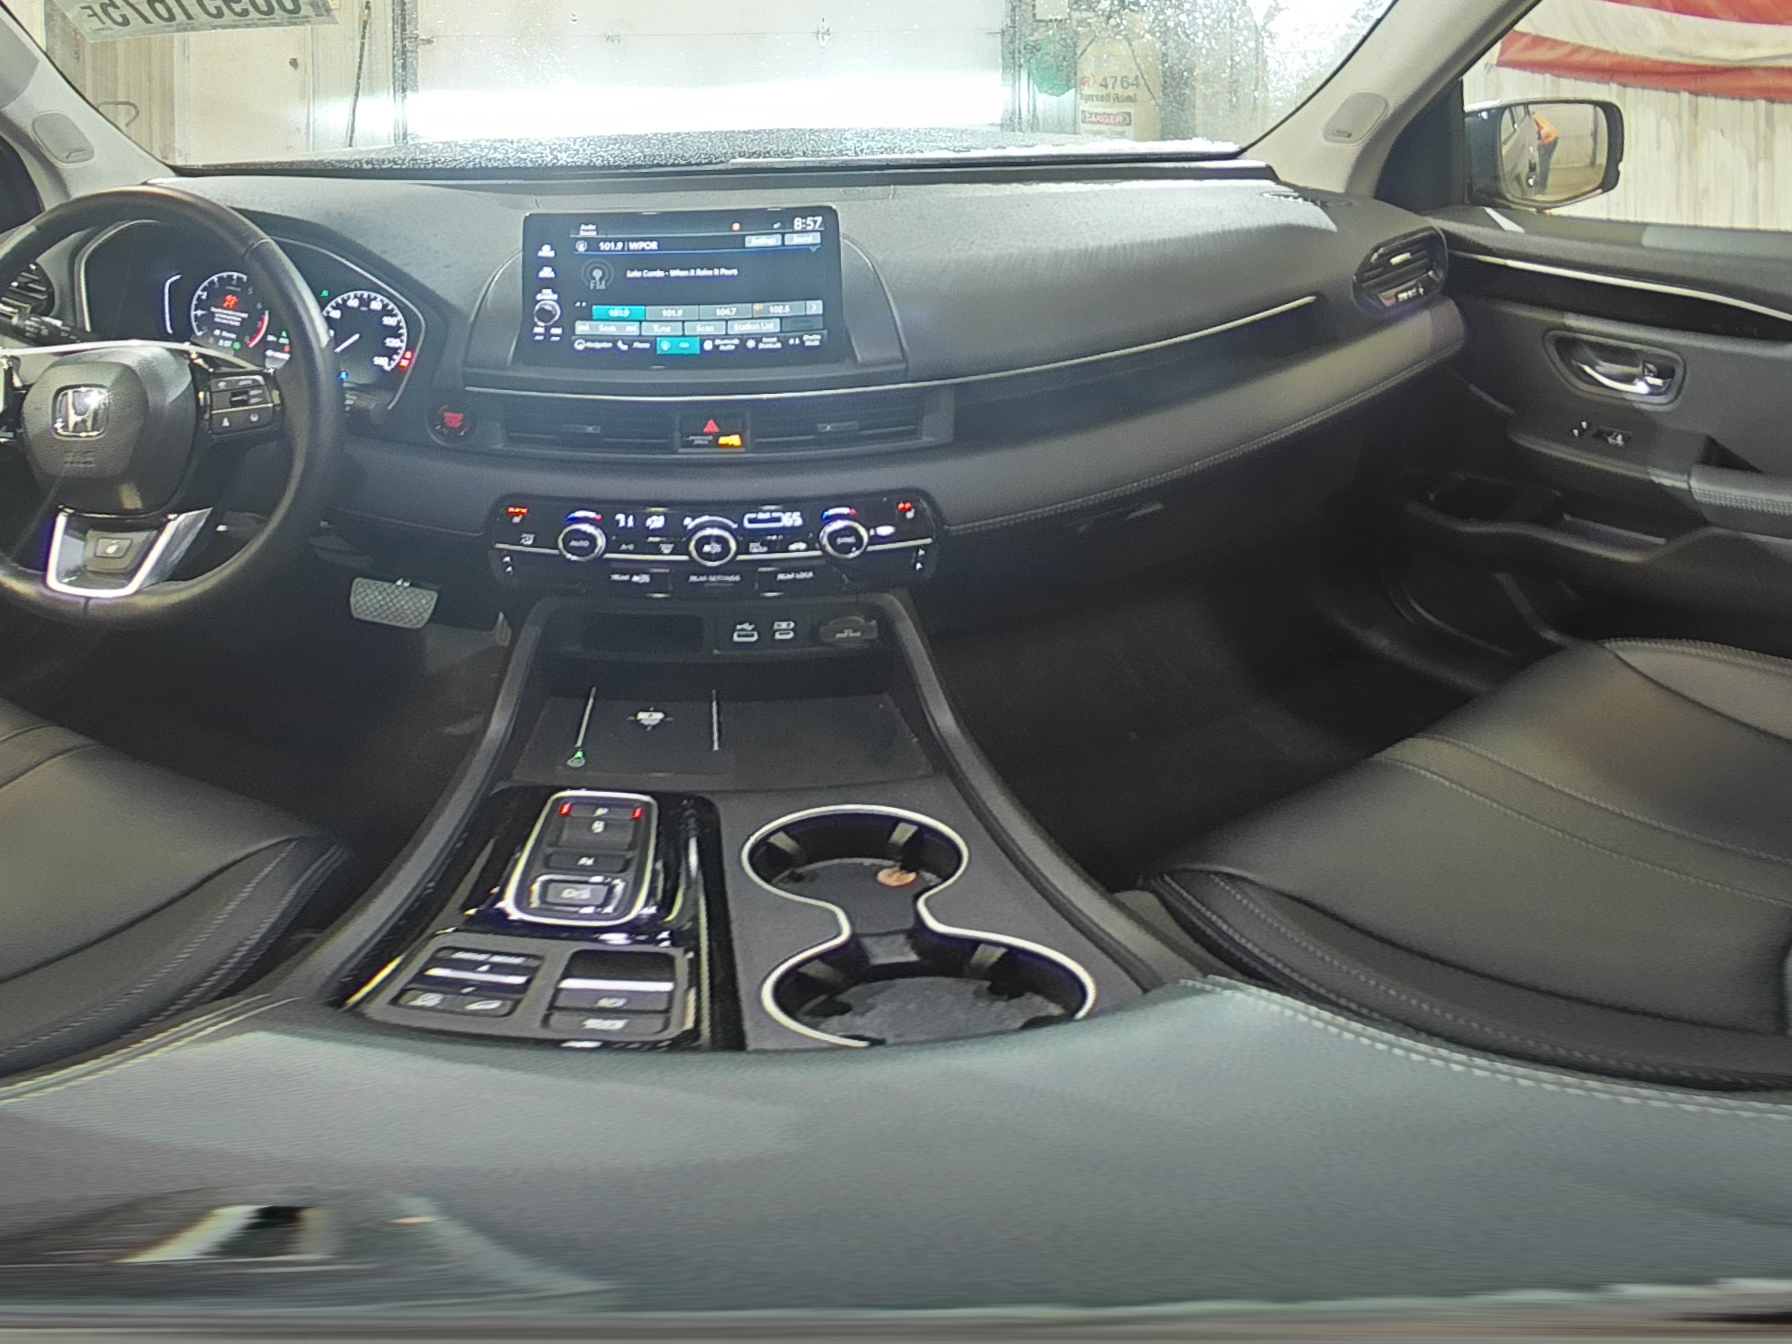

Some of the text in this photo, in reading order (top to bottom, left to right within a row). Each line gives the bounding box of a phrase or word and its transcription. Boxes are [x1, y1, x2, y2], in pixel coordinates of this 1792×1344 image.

[1099, 74, 1140, 90] 4764
[793, 216, 823, 230] 8:57
[599, 240, 658, 251] 101.9 WPOR
[589, 279, 606, 290] FM
[346, 297, 360, 309] 60
[662, 309, 683, 317] 101.9
